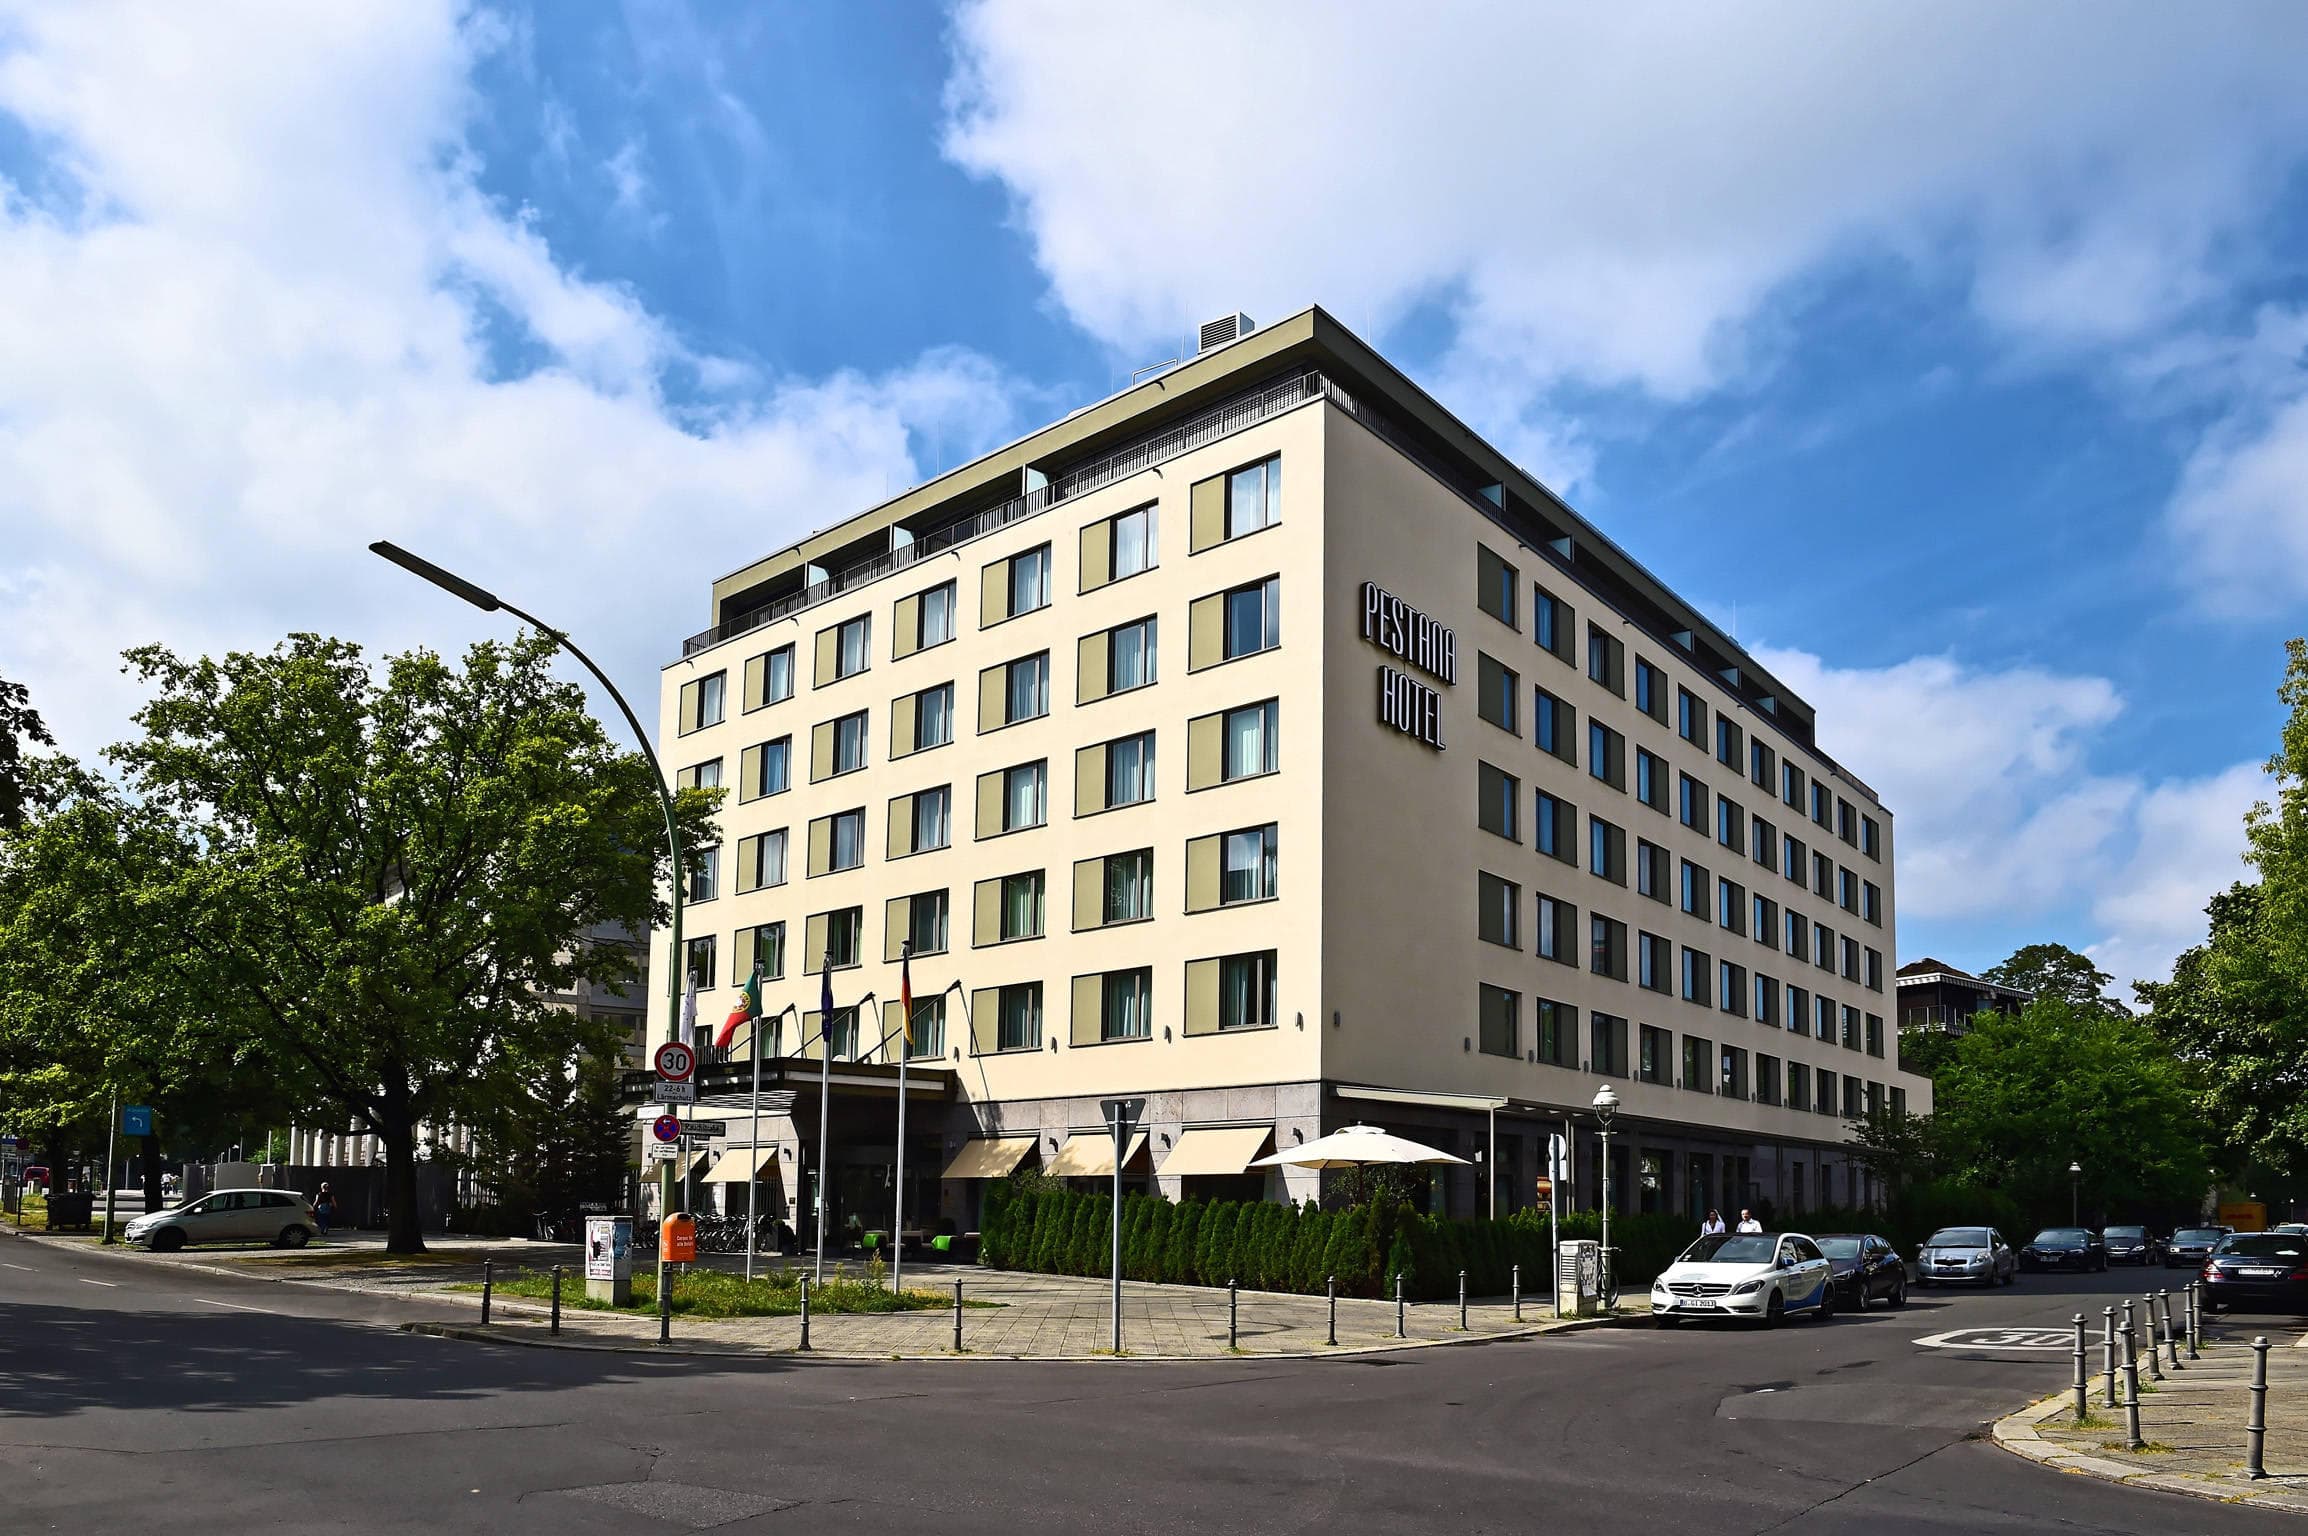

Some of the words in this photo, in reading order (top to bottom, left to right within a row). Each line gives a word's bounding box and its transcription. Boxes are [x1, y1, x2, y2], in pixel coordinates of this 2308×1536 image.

[1361, 580, 1457, 686] PESTANA
[1379, 664, 1446, 751] HOTEL
[663, 1052, 687, 1071] 30
[1971, 1331, 2076, 1346] 30
